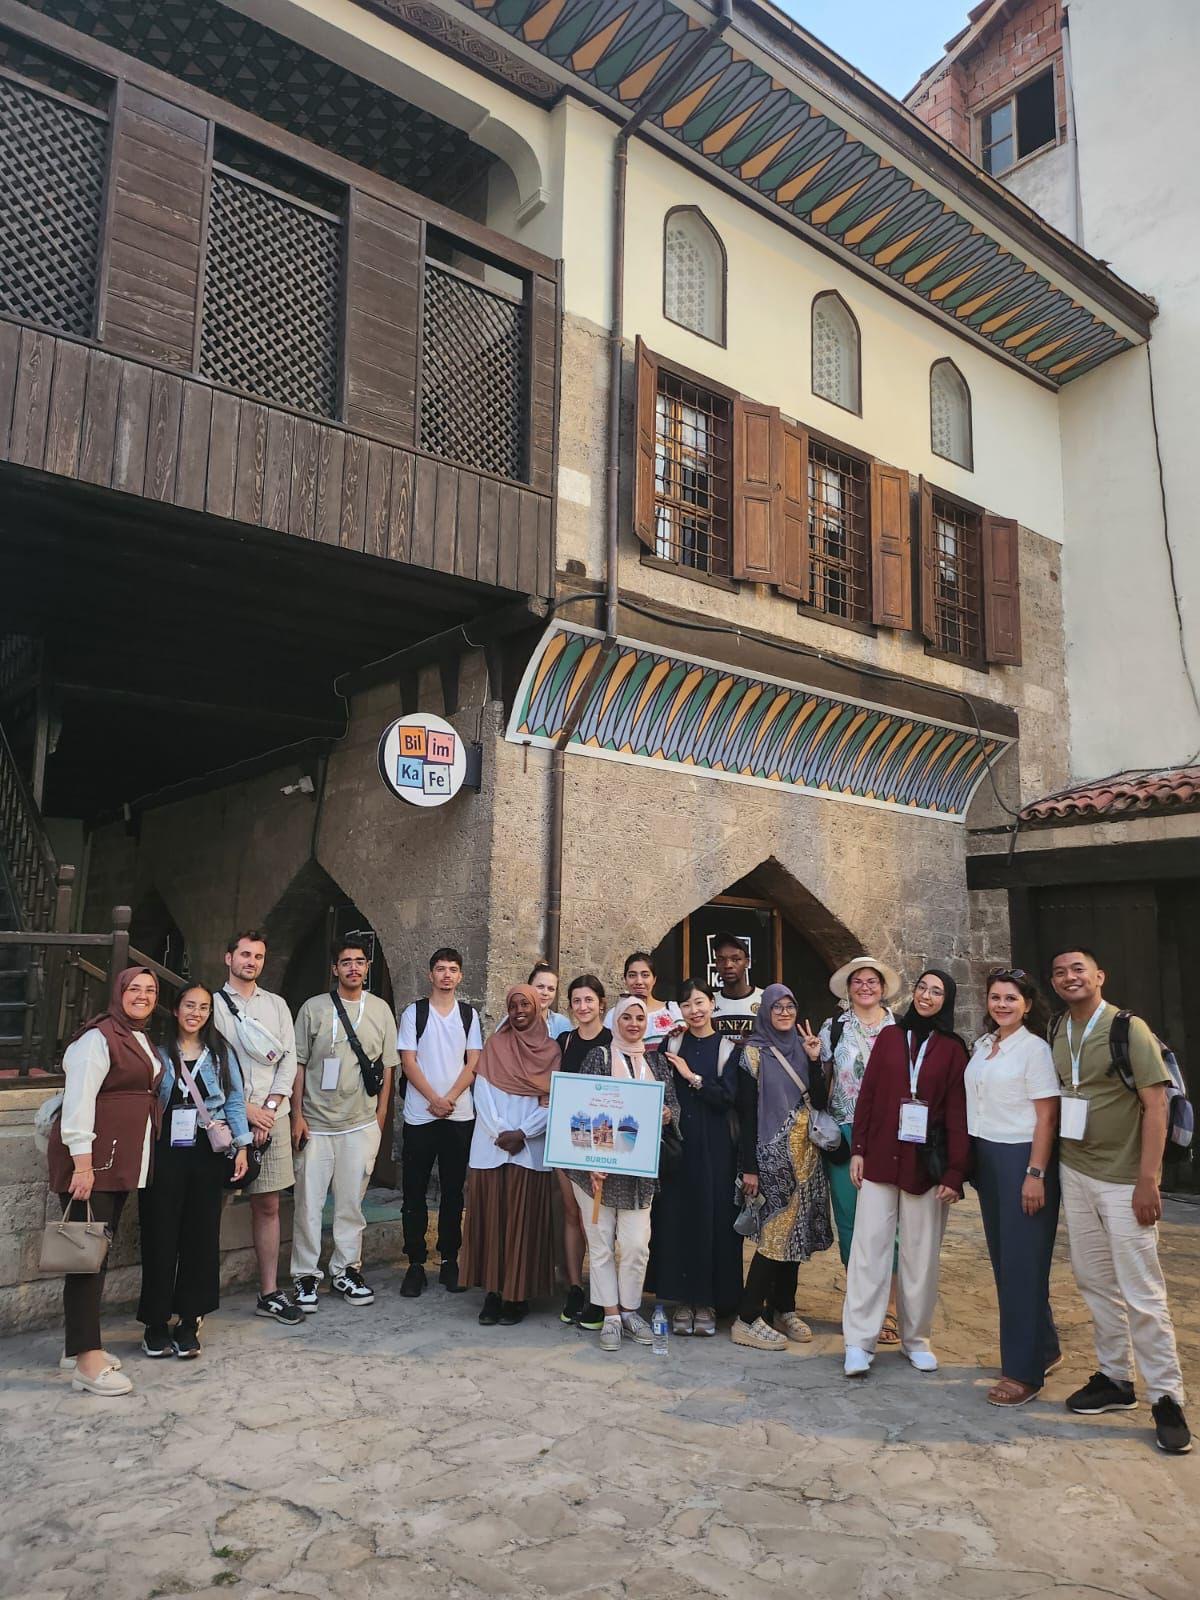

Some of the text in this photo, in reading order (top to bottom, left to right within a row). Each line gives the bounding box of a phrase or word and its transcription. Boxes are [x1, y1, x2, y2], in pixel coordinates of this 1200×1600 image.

[404, 735, 449, 757] Bil im
[401, 763, 444, 787] Ka Fe
[717, 1020, 753, 1031] ENEZI
[584, 1155, 617, 1165] BURDUR
